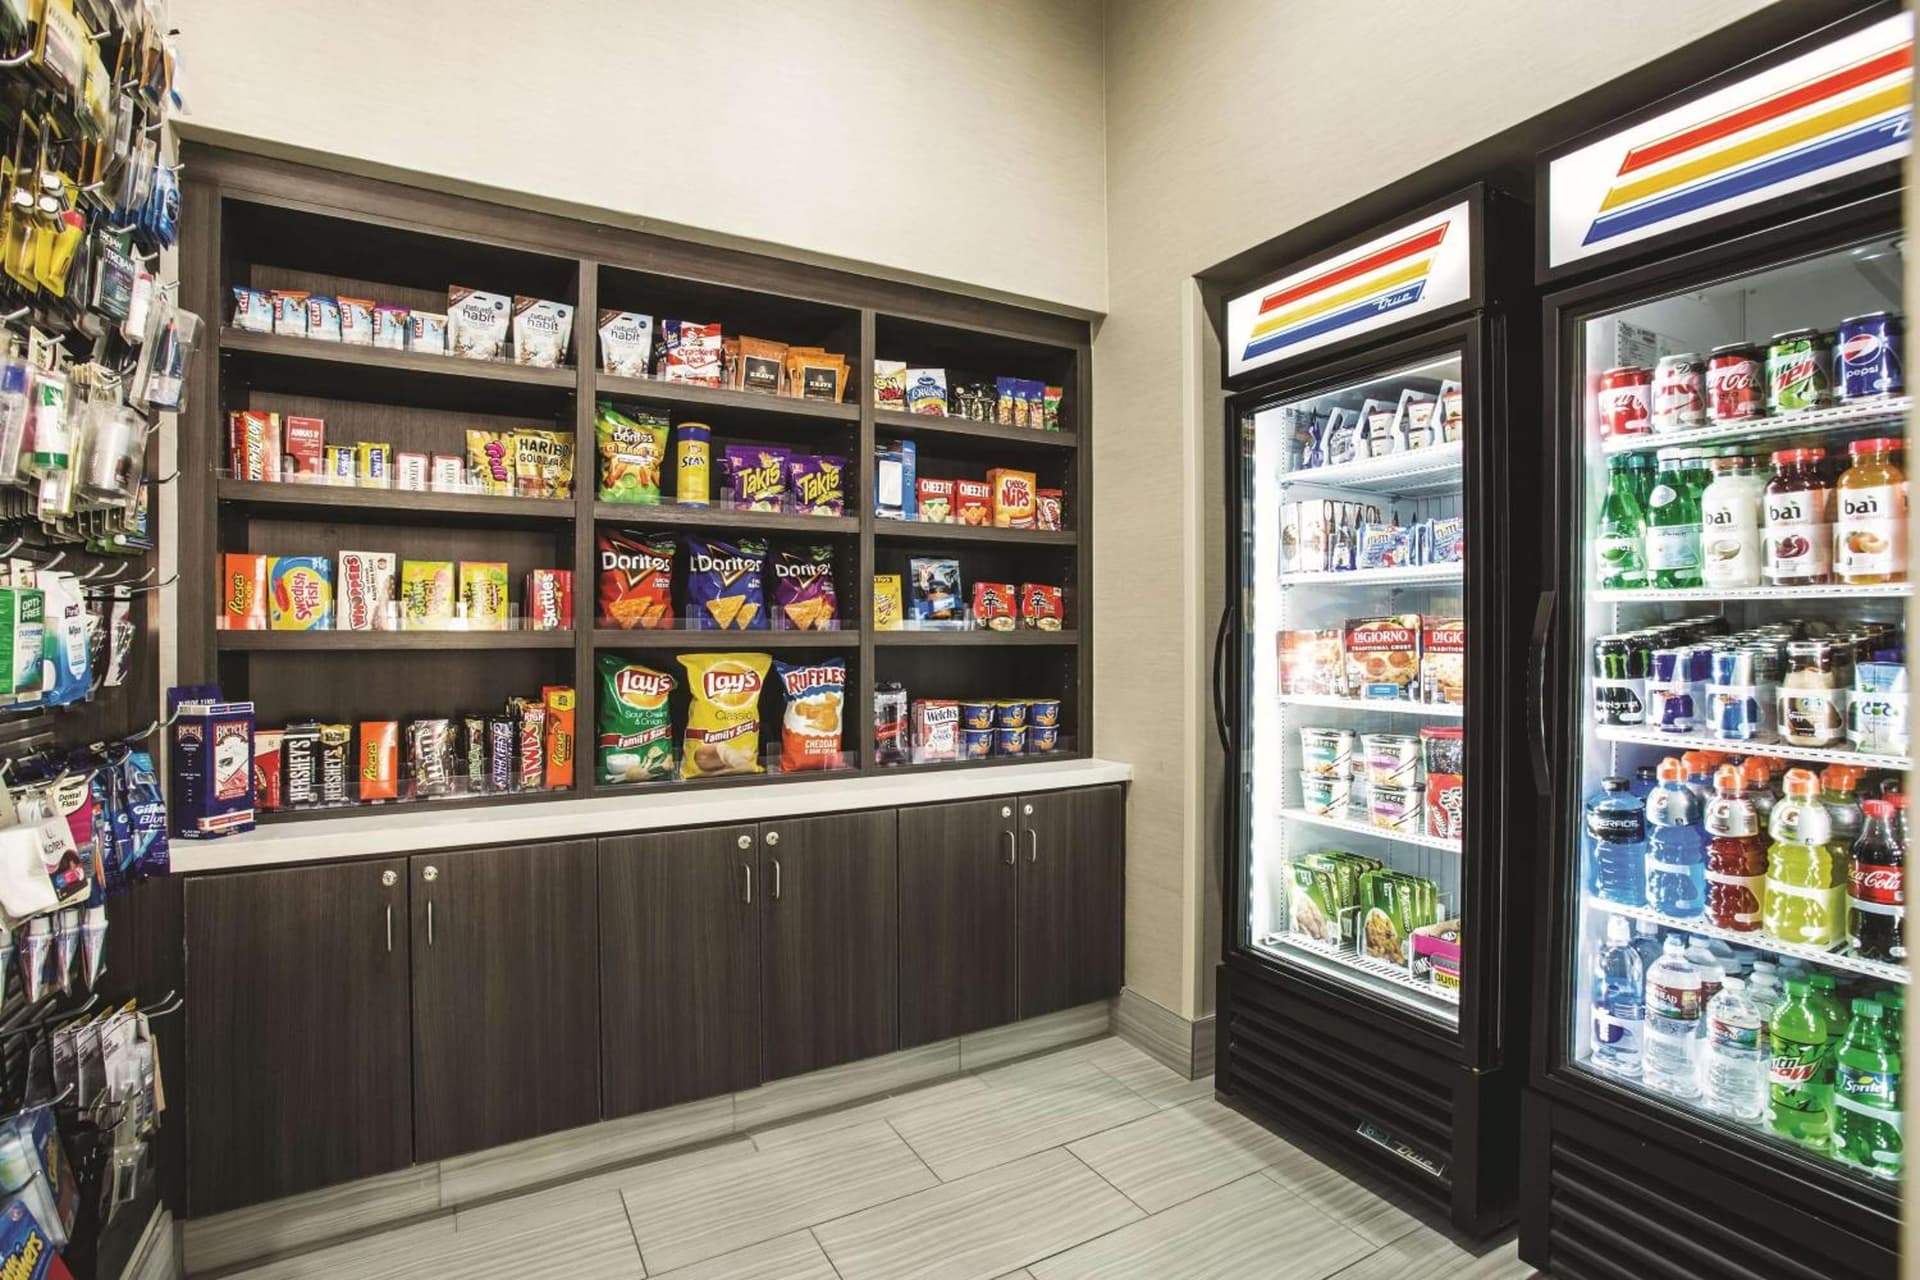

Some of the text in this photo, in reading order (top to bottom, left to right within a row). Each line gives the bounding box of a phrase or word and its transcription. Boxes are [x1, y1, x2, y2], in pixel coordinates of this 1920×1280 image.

[463, 309, 495, 322] habit
[528, 317, 559, 331] habit
[611, 330, 640, 341] habit
[1847, 365, 1879, 379] pepsi
[613, 431, 654, 442] Doritos
[520, 439, 569, 457] HARIBO
[739, 462, 780, 499] Takis
[800, 468, 840, 505] Takis
[1770, 501, 1801, 521] bai
[1845, 497, 1877, 515] bai
[602, 551, 671, 571] Doritos
[228, 574, 245, 615] Reese's
[291, 572, 313, 621] Swedish
[307, 581, 321, 611] Fish
[347, 558, 365, 626] WHOPPERS
[540, 573, 558, 627] Skittles
[23, 609, 41, 621] FREE
[708, 671, 756, 697] Lay's
[786, 667, 847, 694] RUFFLES
[715, 709, 753, 721] Classic
[926, 708, 958, 722] Welch's
[217, 722, 248, 741] BICYCLE
[619, 731, 648, 747] Family
[704, 730, 735, 743] Family
[521, 726, 542, 785] TWIX
[552, 729, 566, 767] Reese's
[363, 741, 377, 782] Reese's
[494, 730, 510, 789] SNICKERS
[290, 739, 311, 801] HERSHEY'S
[324, 749, 342, 801] HERSHEY'S
[59, 791, 82, 801] Dental
[62, 799, 79, 808] Floss
